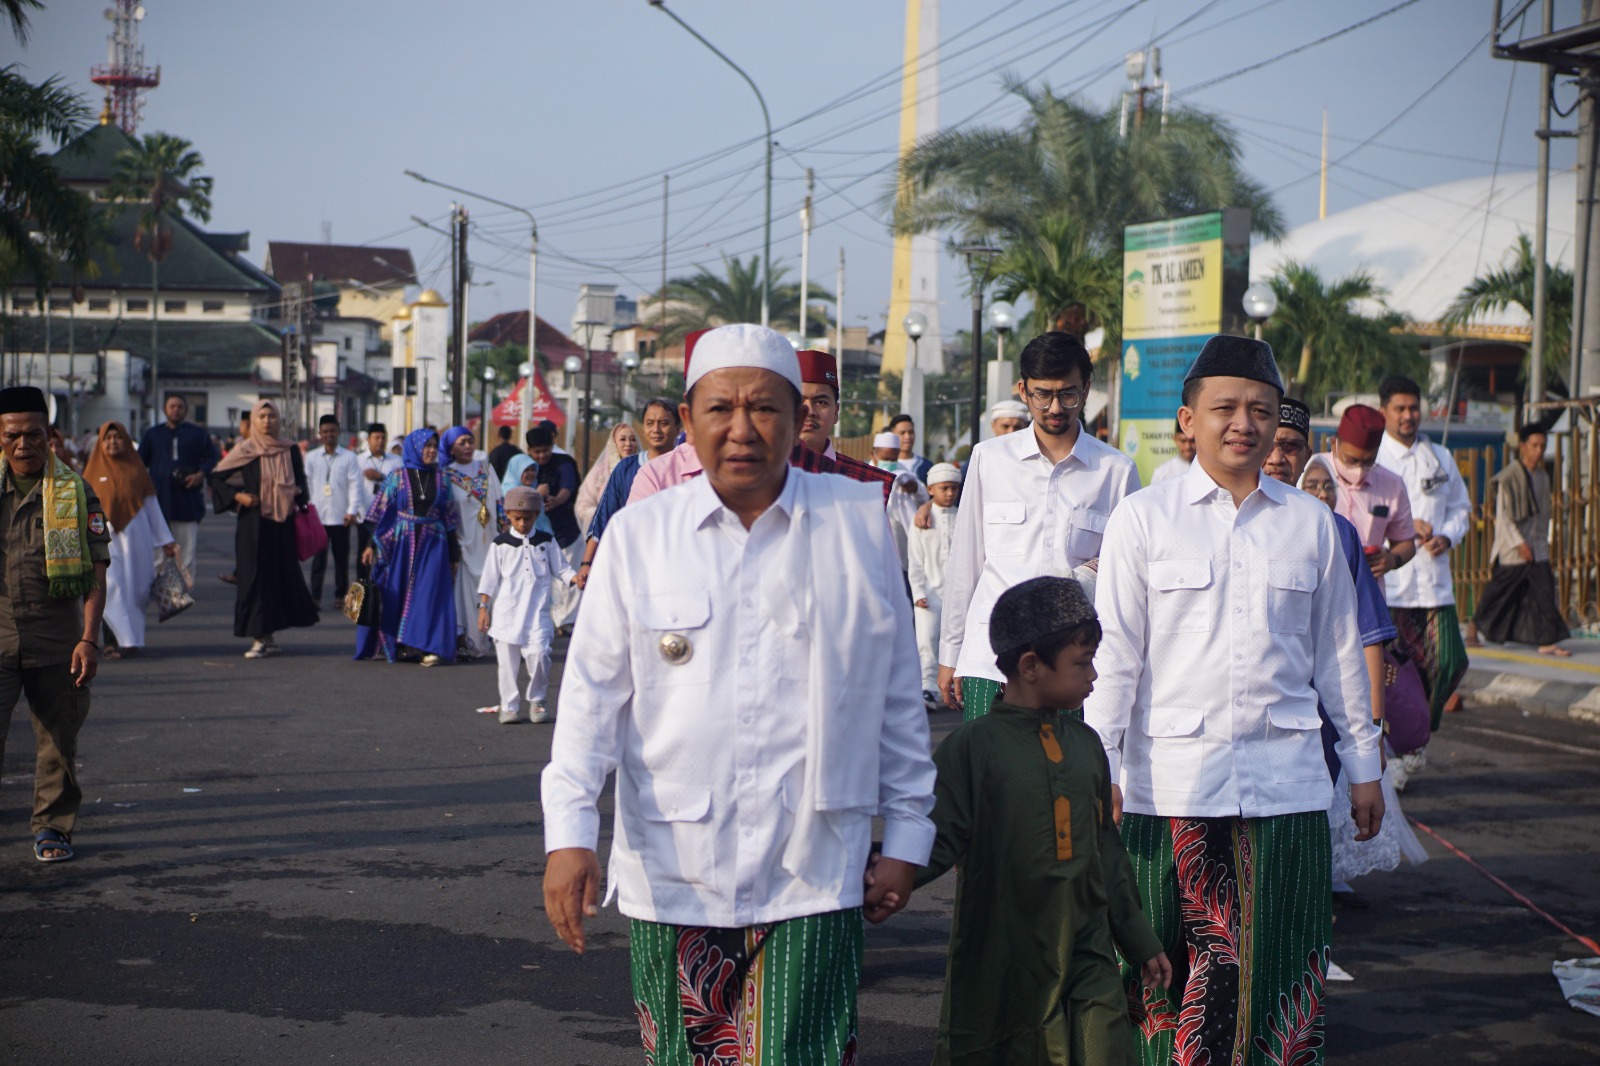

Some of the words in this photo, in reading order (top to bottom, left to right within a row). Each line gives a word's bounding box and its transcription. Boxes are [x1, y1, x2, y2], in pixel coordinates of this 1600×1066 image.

[1151, 264, 1162, 285] TK
[1164, 262, 1176, 283] AL
[1178, 258, 1205, 283] AMIEN
[1142, 431, 1162, 440] TAMAN
